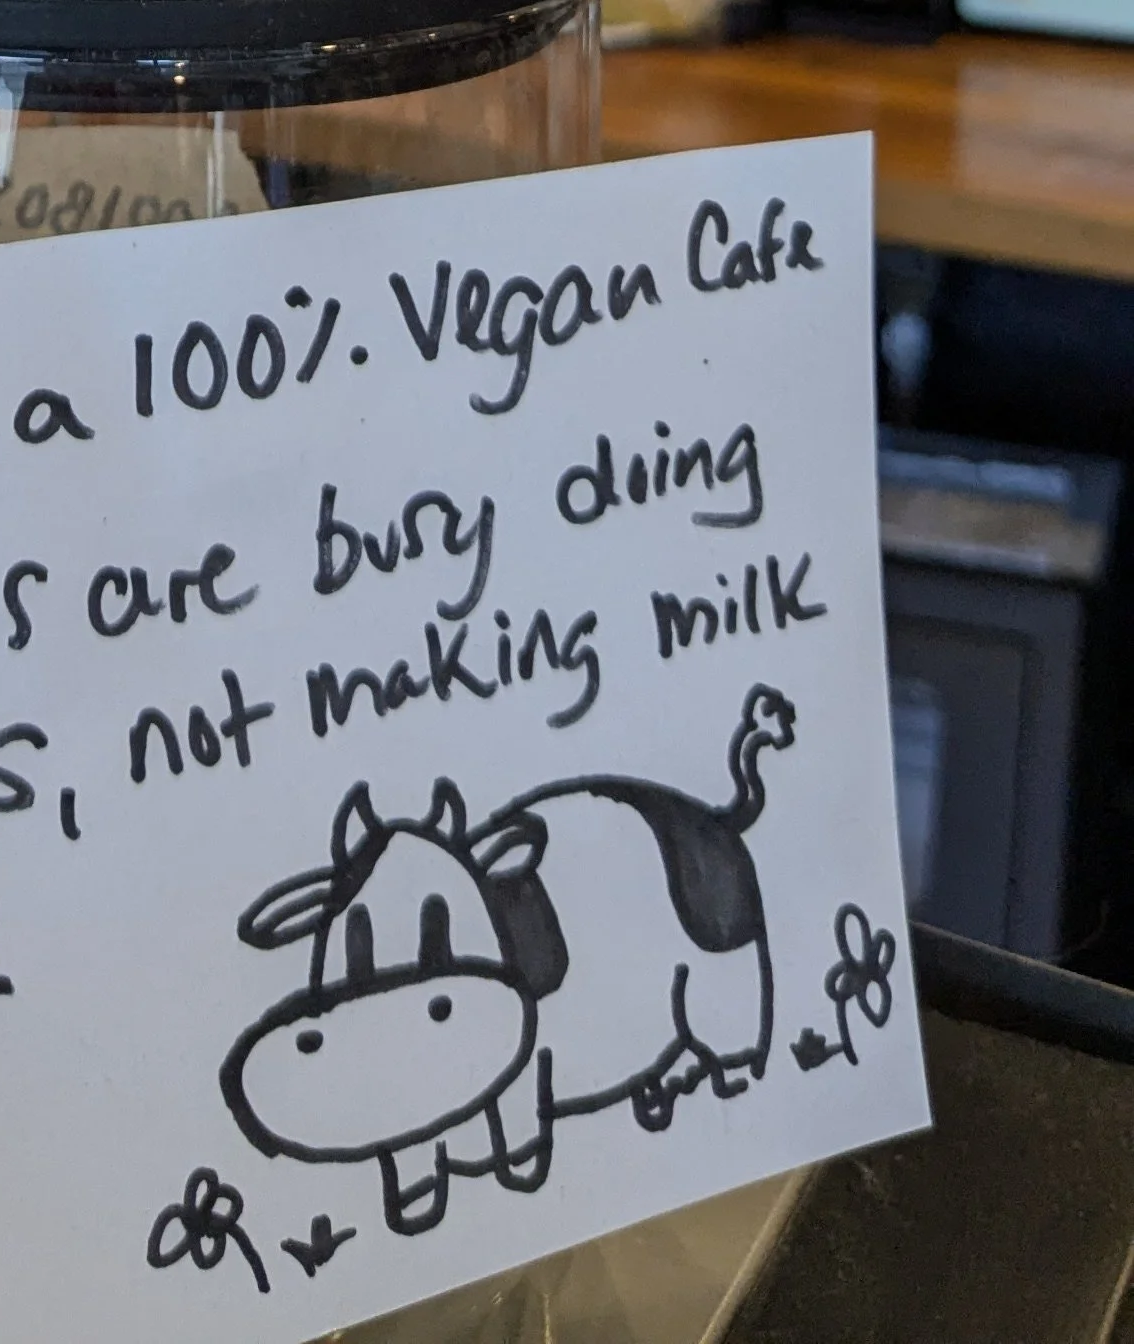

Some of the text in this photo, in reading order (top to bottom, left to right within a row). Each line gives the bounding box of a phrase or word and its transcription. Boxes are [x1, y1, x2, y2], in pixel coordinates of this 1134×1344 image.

[14, 388, 96, 444] a
[389, 259, 662, 416] Vegan
[687, 198, 825, 294] Cafe
[87, 542, 260, 638] are
[312, 482, 495, 621] busy
[555, 420, 763, 529] doing
[129, 668, 275, 784] not
[307, 608, 599, 737] making
[650, 551, 829, 660] milk
